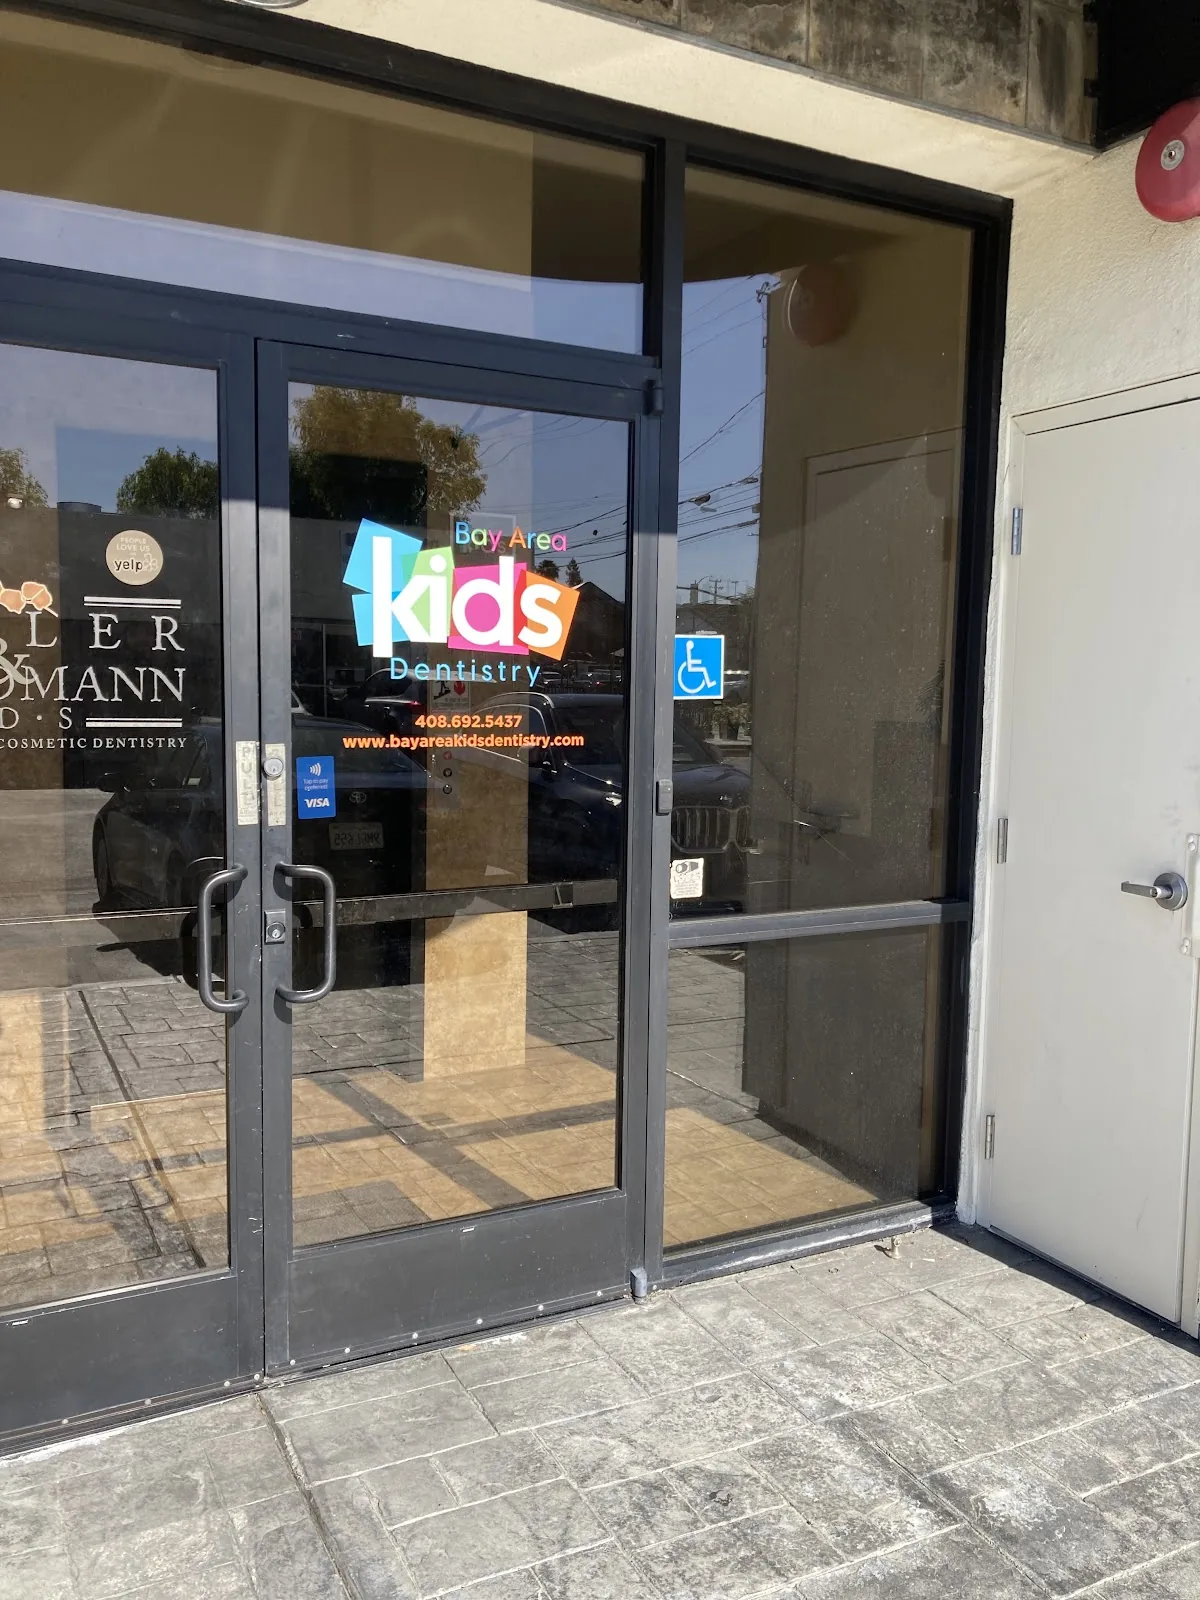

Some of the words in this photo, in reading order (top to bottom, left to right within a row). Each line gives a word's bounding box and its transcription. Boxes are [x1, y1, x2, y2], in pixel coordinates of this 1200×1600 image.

[120, 537, 147, 545] PEOPLE
[455, 521, 501, 552] Bay
[508, 526, 568, 552] Area
[116, 543, 137, 551] LOVE
[139, 544, 150, 552] US
[114, 558, 143, 573] yelp
[372, 535, 563, 658] kids
[390, 657, 541, 688] Dentistry
[414, 714, 523, 729] 408.692.5437
[92, 737, 188, 749] DENTISTRY
[342, 733, 585, 751] www.bayareakidsdentistry.com
[304, 797, 330, 809] VISA
